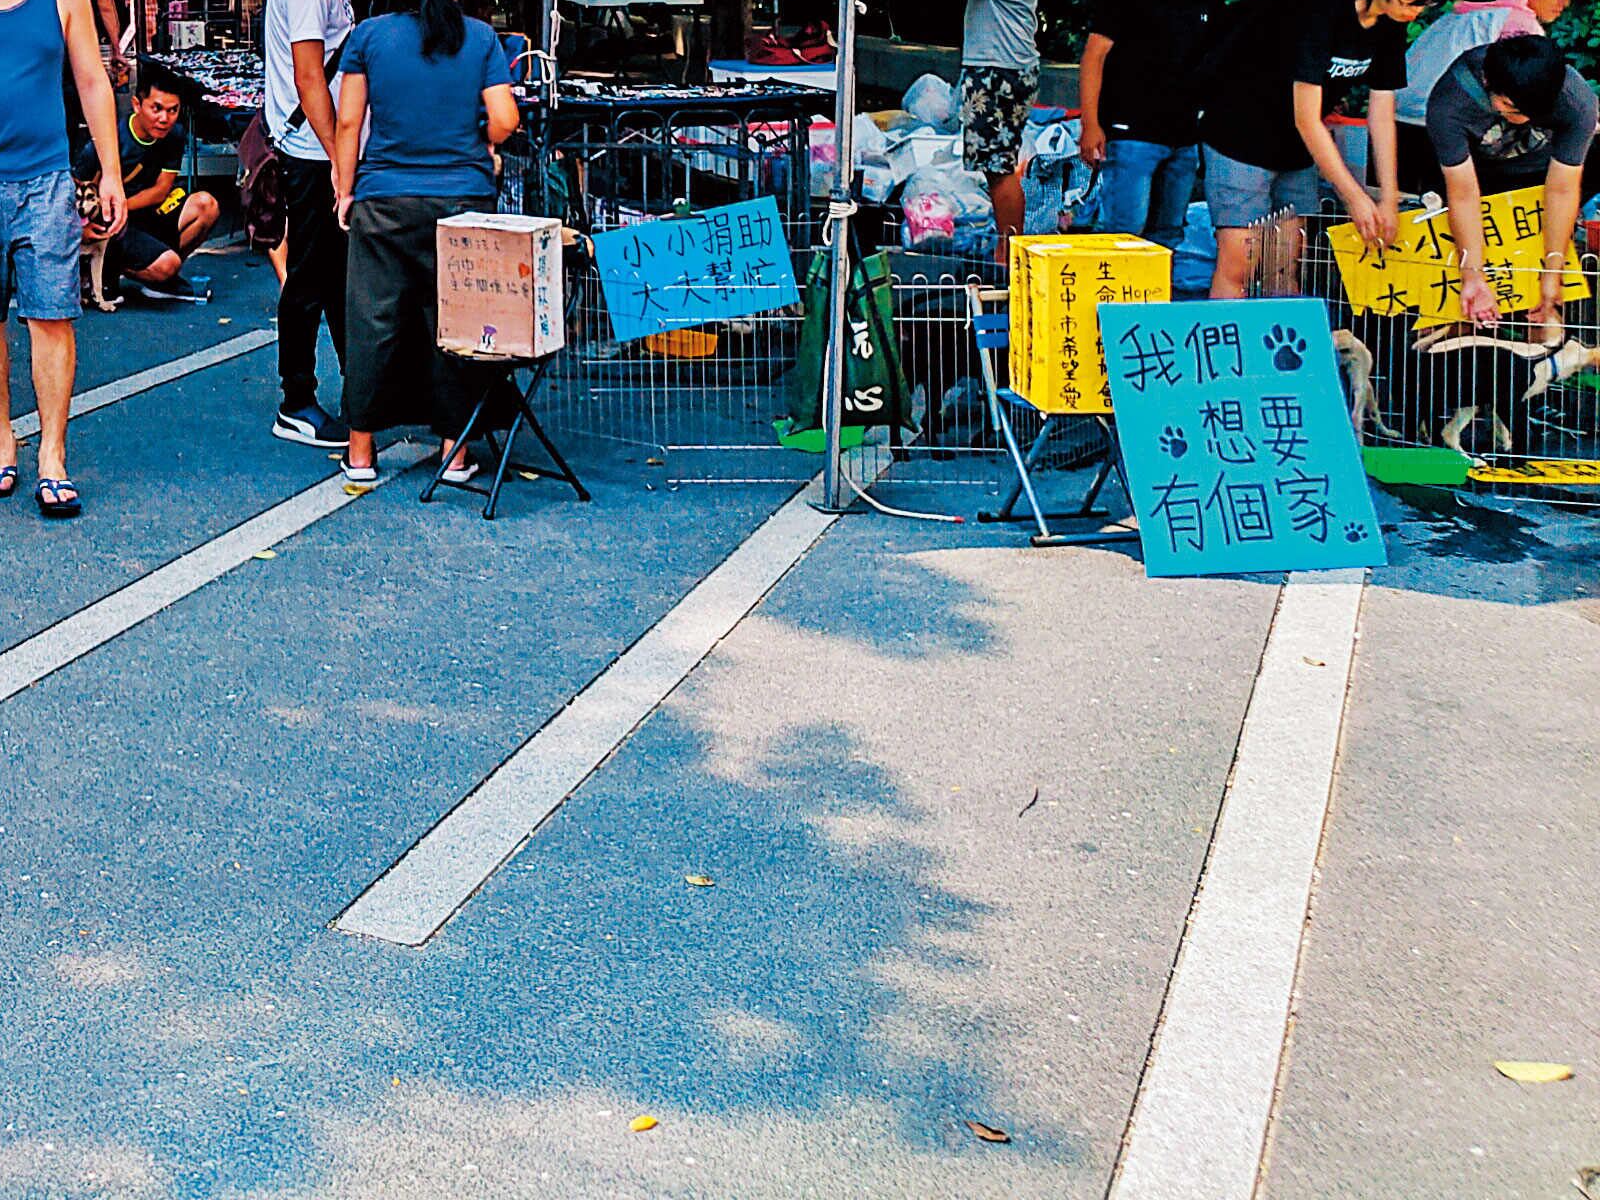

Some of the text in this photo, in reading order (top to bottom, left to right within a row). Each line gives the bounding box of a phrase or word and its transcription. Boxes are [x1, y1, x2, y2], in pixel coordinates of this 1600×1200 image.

[623, 210, 773, 268] 小小捐助
[632, 257, 777, 321] 大大幫忙
[1123, 284, 1163, 303] Hope
[1059, 263, 1082, 410] 台中市希望愛
[1119, 321, 1243, 392] 我們
[1198, 396, 1309, 466] 想要
[1149, 467, 1337, 553] 有個家
